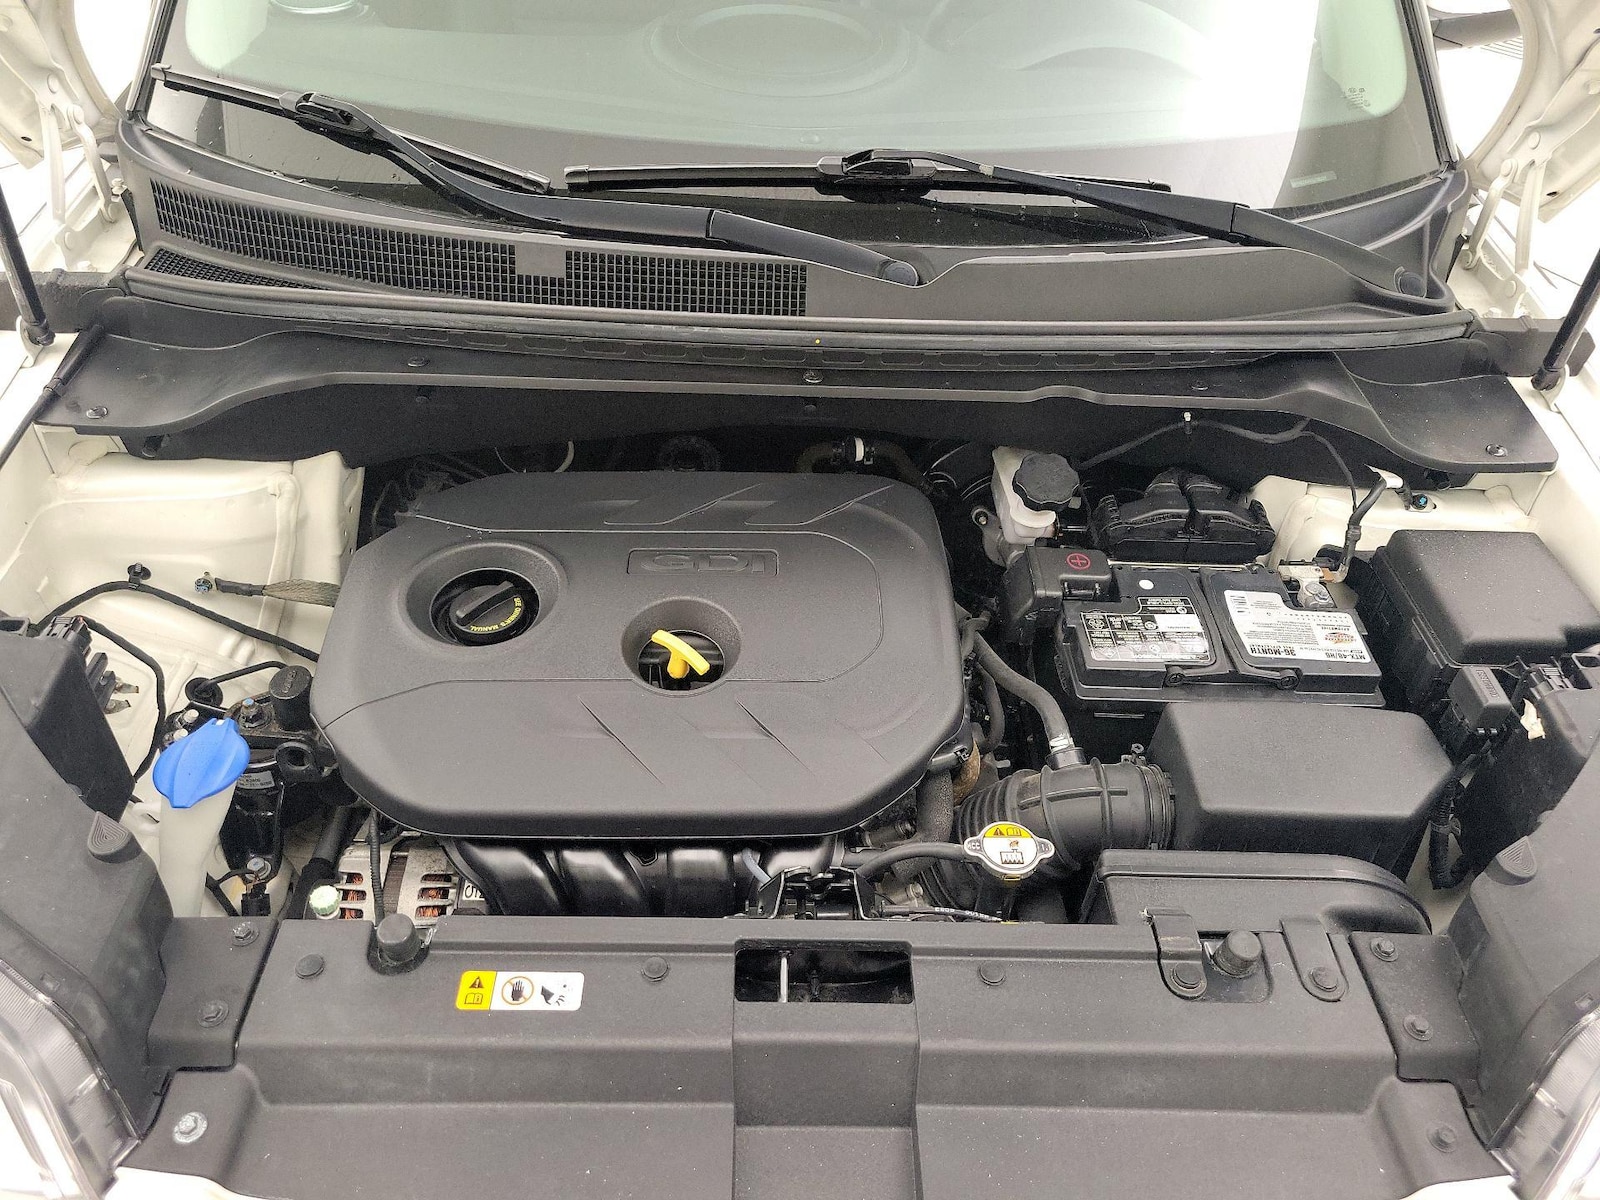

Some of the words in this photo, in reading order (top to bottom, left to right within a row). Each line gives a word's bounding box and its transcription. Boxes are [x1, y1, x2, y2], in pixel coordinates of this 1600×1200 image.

[640, 553, 766, 574] GDI
[513, 597, 522, 607] SEE
[470, 624, 499, 632] MANUAL
[1250, 647, 1297, 657] 36-MONTH
